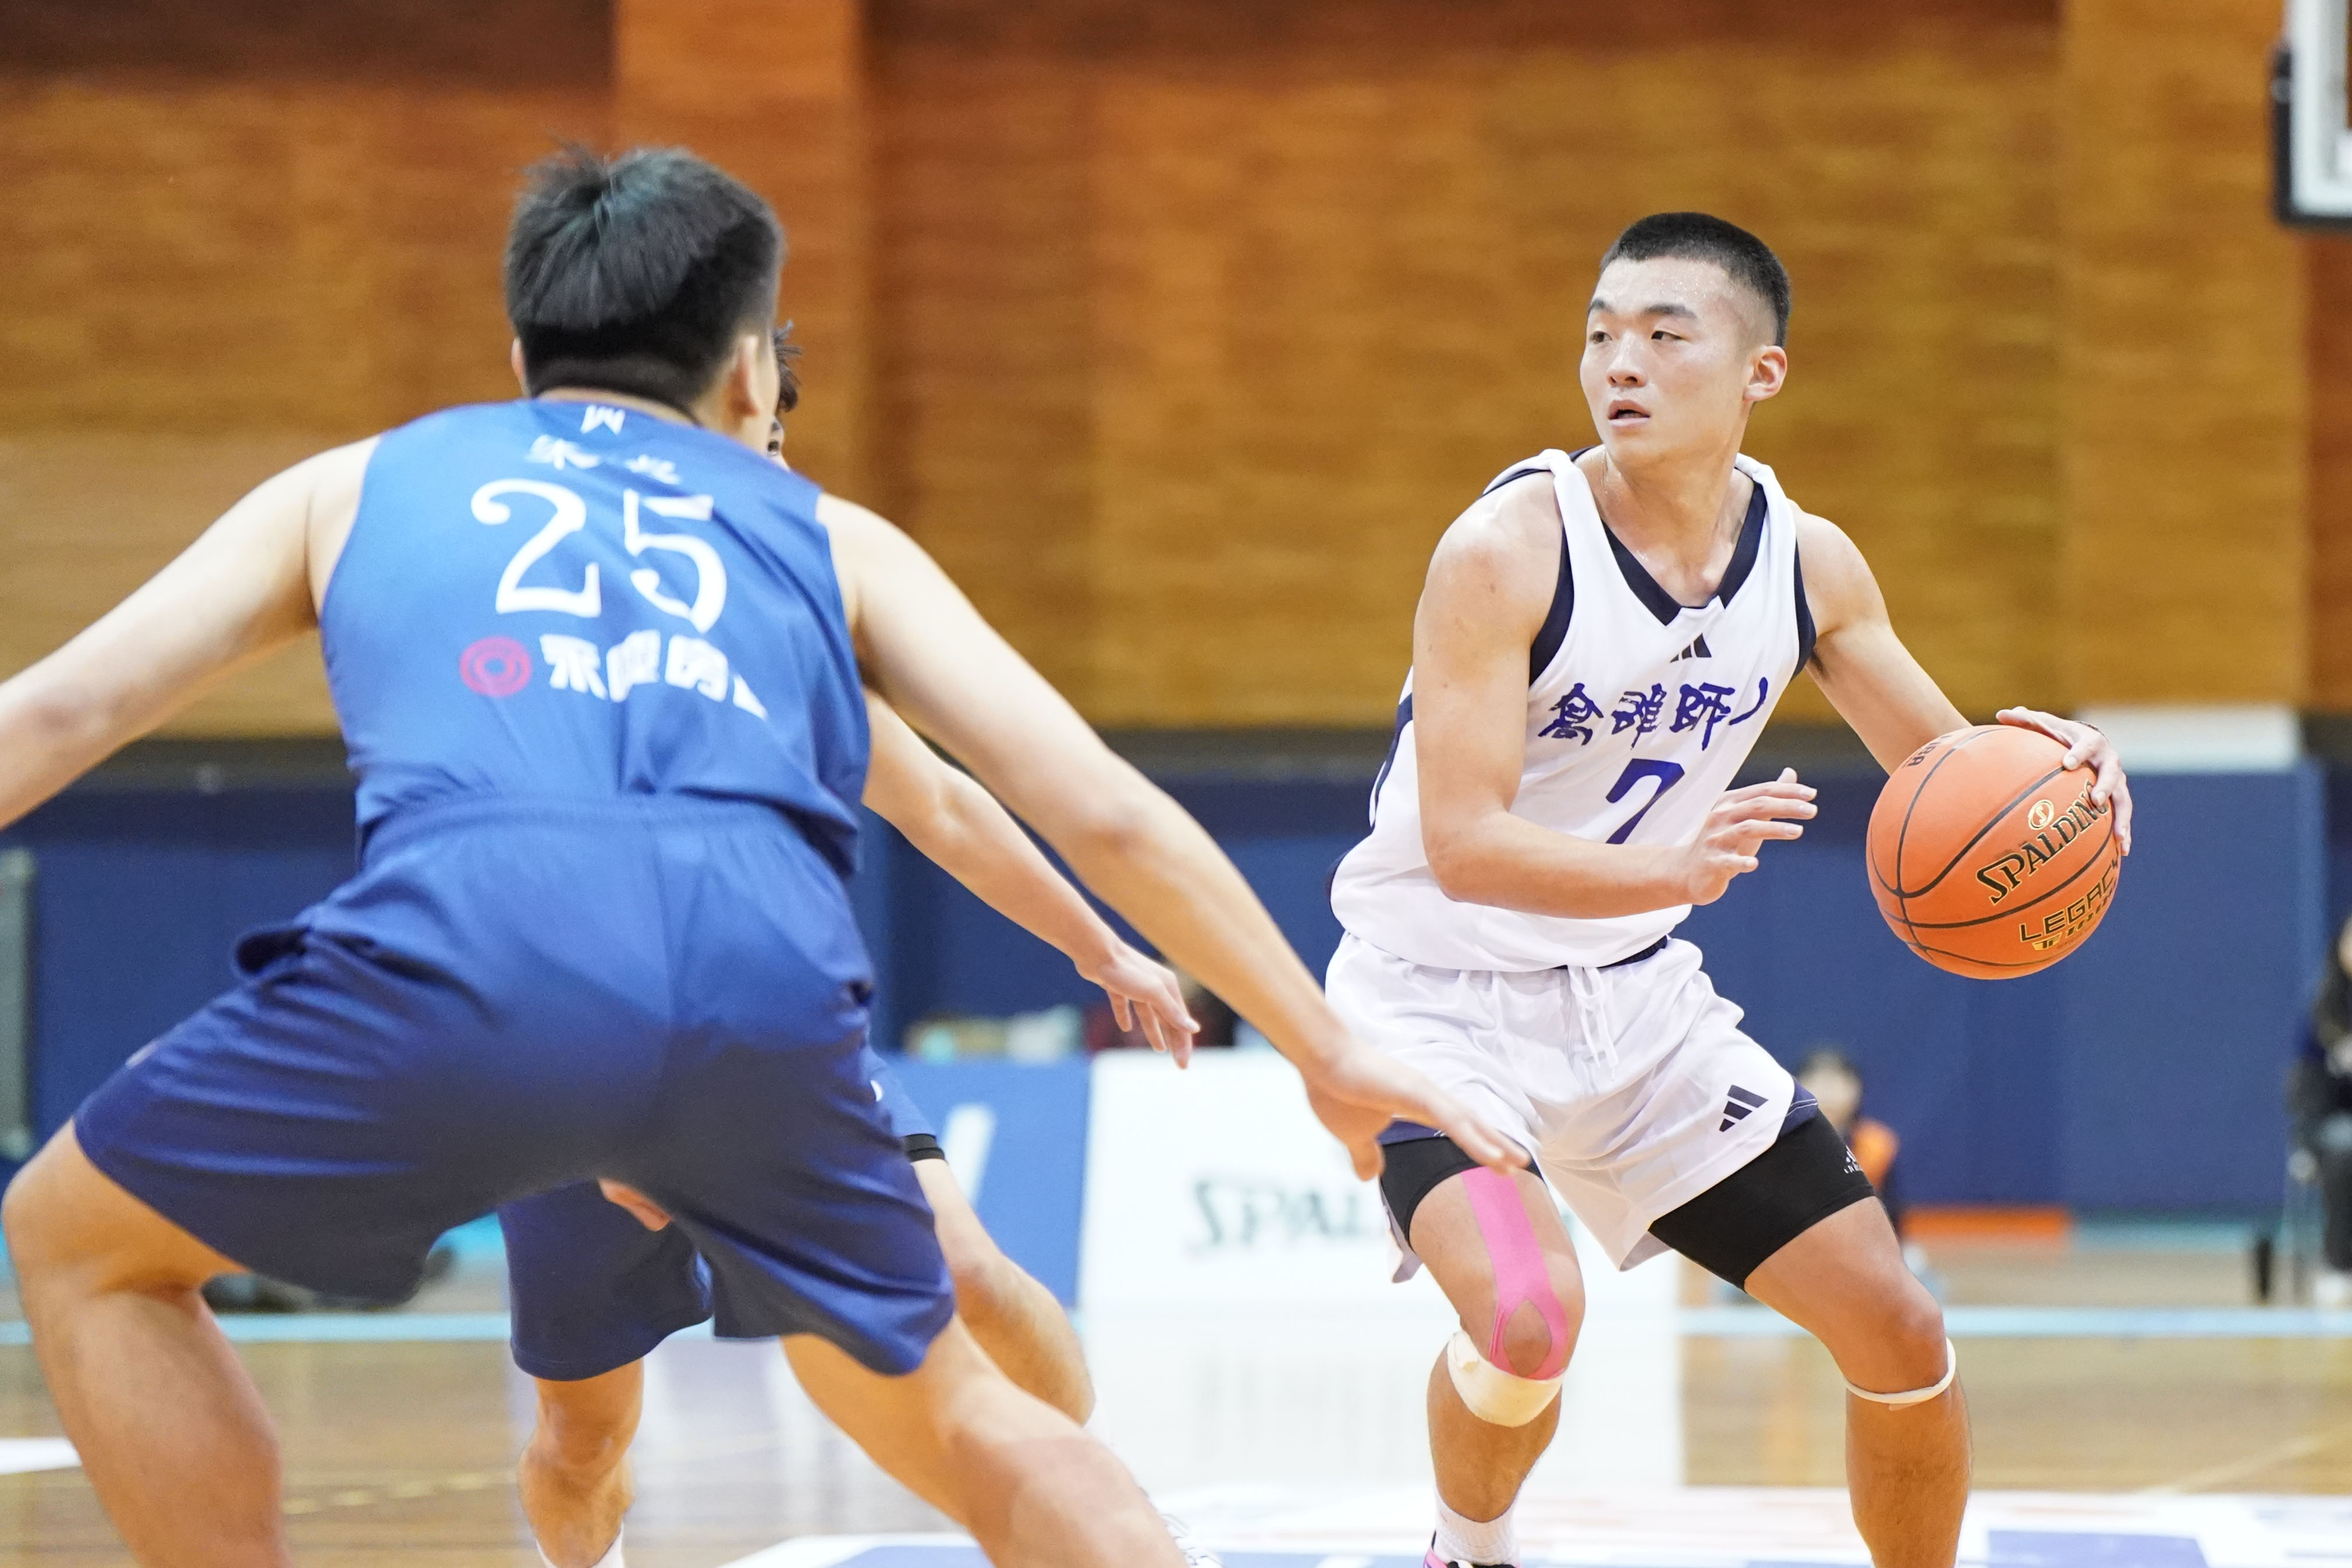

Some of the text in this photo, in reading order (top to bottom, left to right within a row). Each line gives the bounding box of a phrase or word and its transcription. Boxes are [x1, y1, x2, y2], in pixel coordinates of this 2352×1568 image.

[471, 478, 727, 634] 25
[1538, 676, 1768, 751] 高雄師
[1605, 758, 1686, 845] 7
[1185, 1178, 1384, 1256] SPAL
